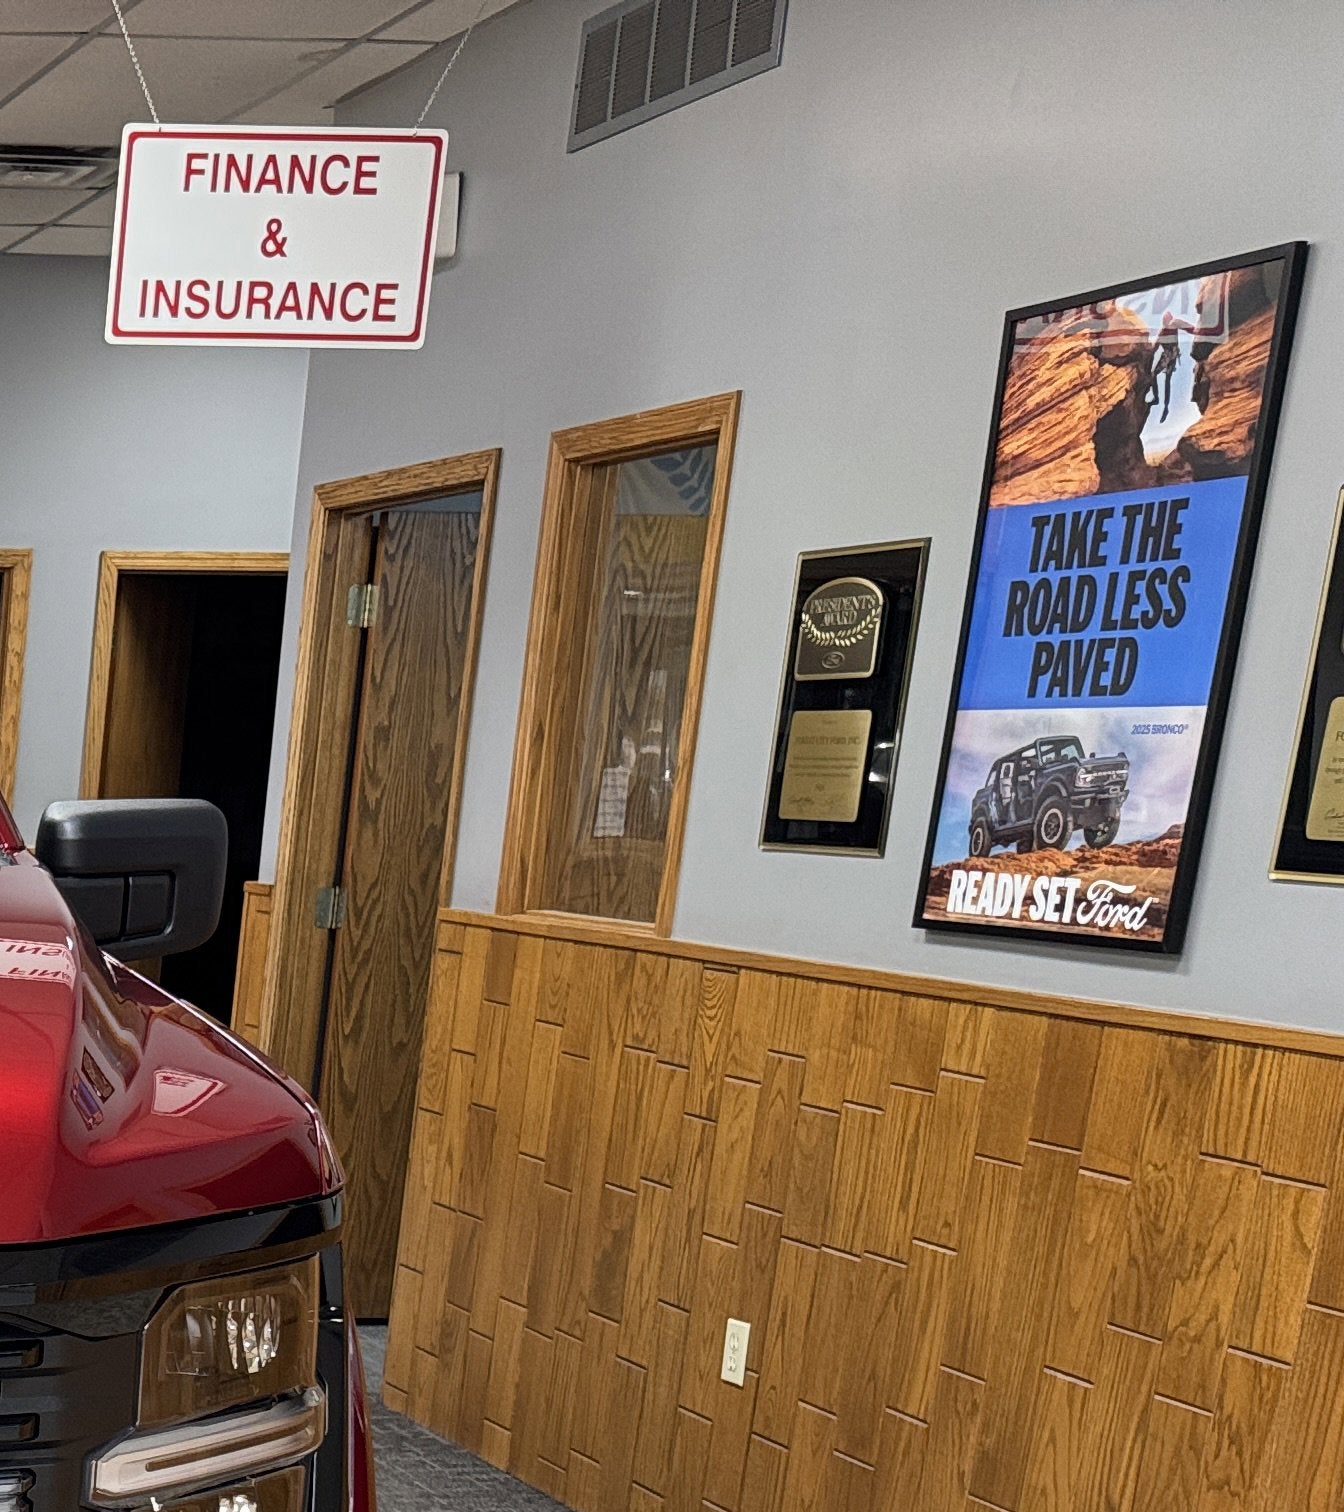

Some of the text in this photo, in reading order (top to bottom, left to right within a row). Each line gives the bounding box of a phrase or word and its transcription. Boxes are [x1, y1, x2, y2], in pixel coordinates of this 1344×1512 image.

[183, 152, 381, 196] FINANCE
[260, 218, 288, 258] &
[138, 279, 400, 323] INSURANCE
[1029, 497, 1190, 573] TAKE THE
[1002, 565, 1191, 637] ROAD LESS
[1027, 636, 1139, 698] PAVED
[946, 869, 1154, 931] READY SET Ford
